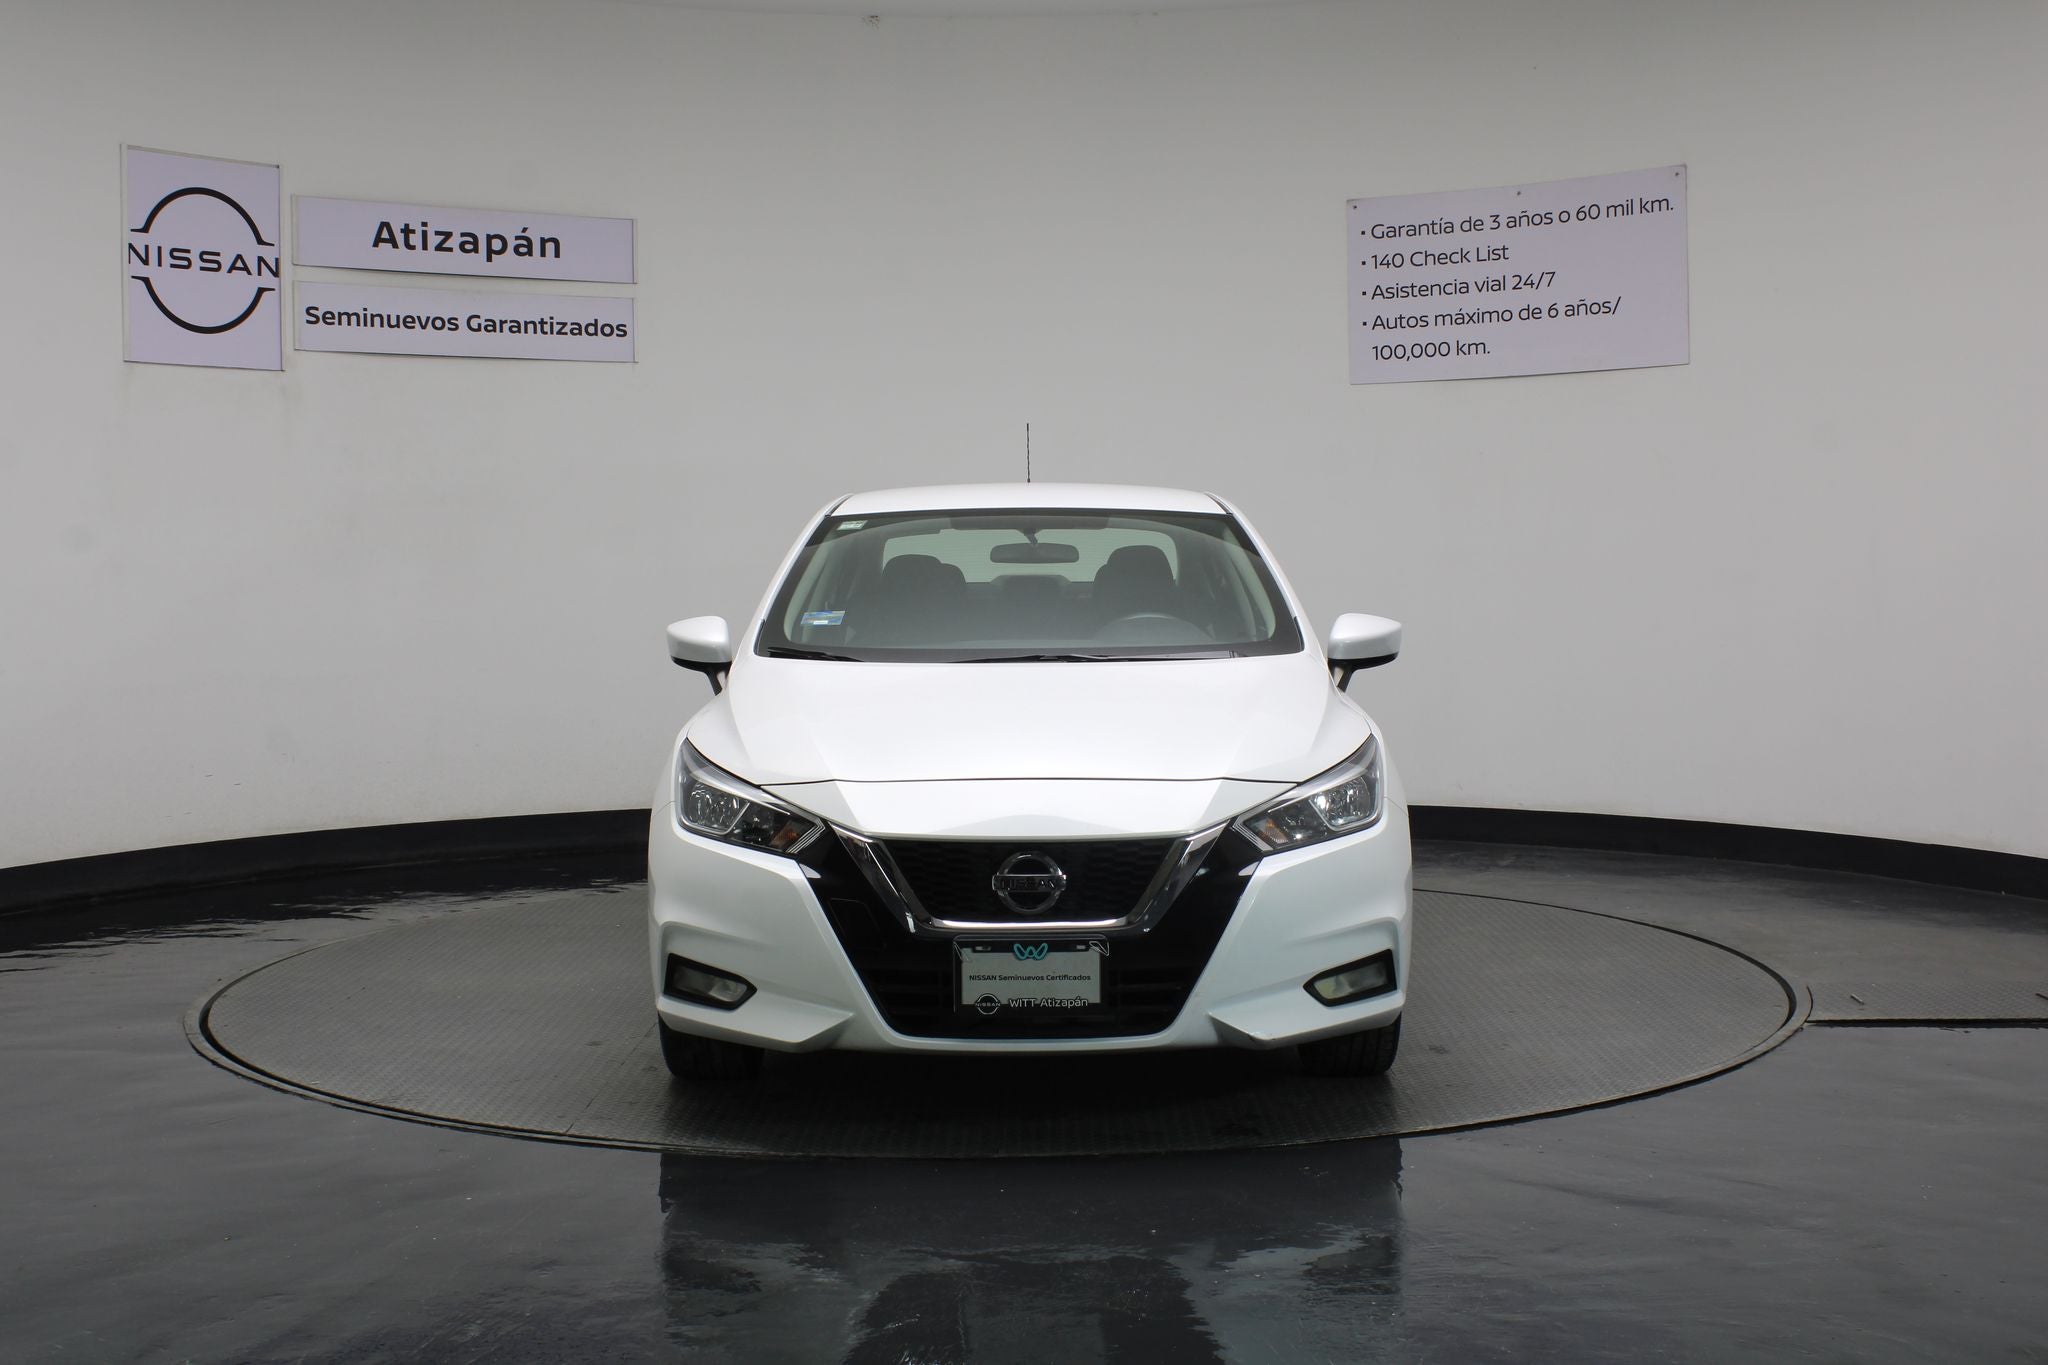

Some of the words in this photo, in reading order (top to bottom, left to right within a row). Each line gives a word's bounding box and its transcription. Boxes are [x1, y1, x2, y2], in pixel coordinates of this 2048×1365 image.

[1371, 217, 1455, 240] Garantía
[1460, 216, 1485, 232] de
[1490, 215, 1501, 230] 3
[1506, 210, 1554, 229] años
[1559, 211, 1571, 224] o
[1576, 204, 1601, 221] 60
[1607, 199, 1634, 218] mil
[1639, 197, 1674, 215] km.
[372, 222, 561, 263] Atizapán
[1371, 253, 1405, 270] 140
[1410, 248, 1472, 267] Check
[1477, 244, 1510, 262] List
[128, 243, 279, 278] NISSAN
[1372, 280, 1470, 300] Asistencia
[1475, 275, 1506, 293] vial
[1512, 271, 1556, 291] 24/7
[305, 306, 460, 332] Seminuevos
[466, 315, 628, 338] Garantizados
[1372, 313, 1430, 331] Autos
[1434, 308, 1514, 327] máximo
[1519, 304, 1543, 321] de
[1548, 303, 1559, 319] 6
[1565, 296, 1622, 318] años/
[1372, 341, 1451, 362] 100,000
[1456, 340, 1491, 356] km.
[999, 973, 1045, 981] Seminuevos
[1046, 973, 1091, 981] Certificados
[1009, 998, 1036, 1008] WITT
[1040, 995, 1088, 1009] Atizapán
